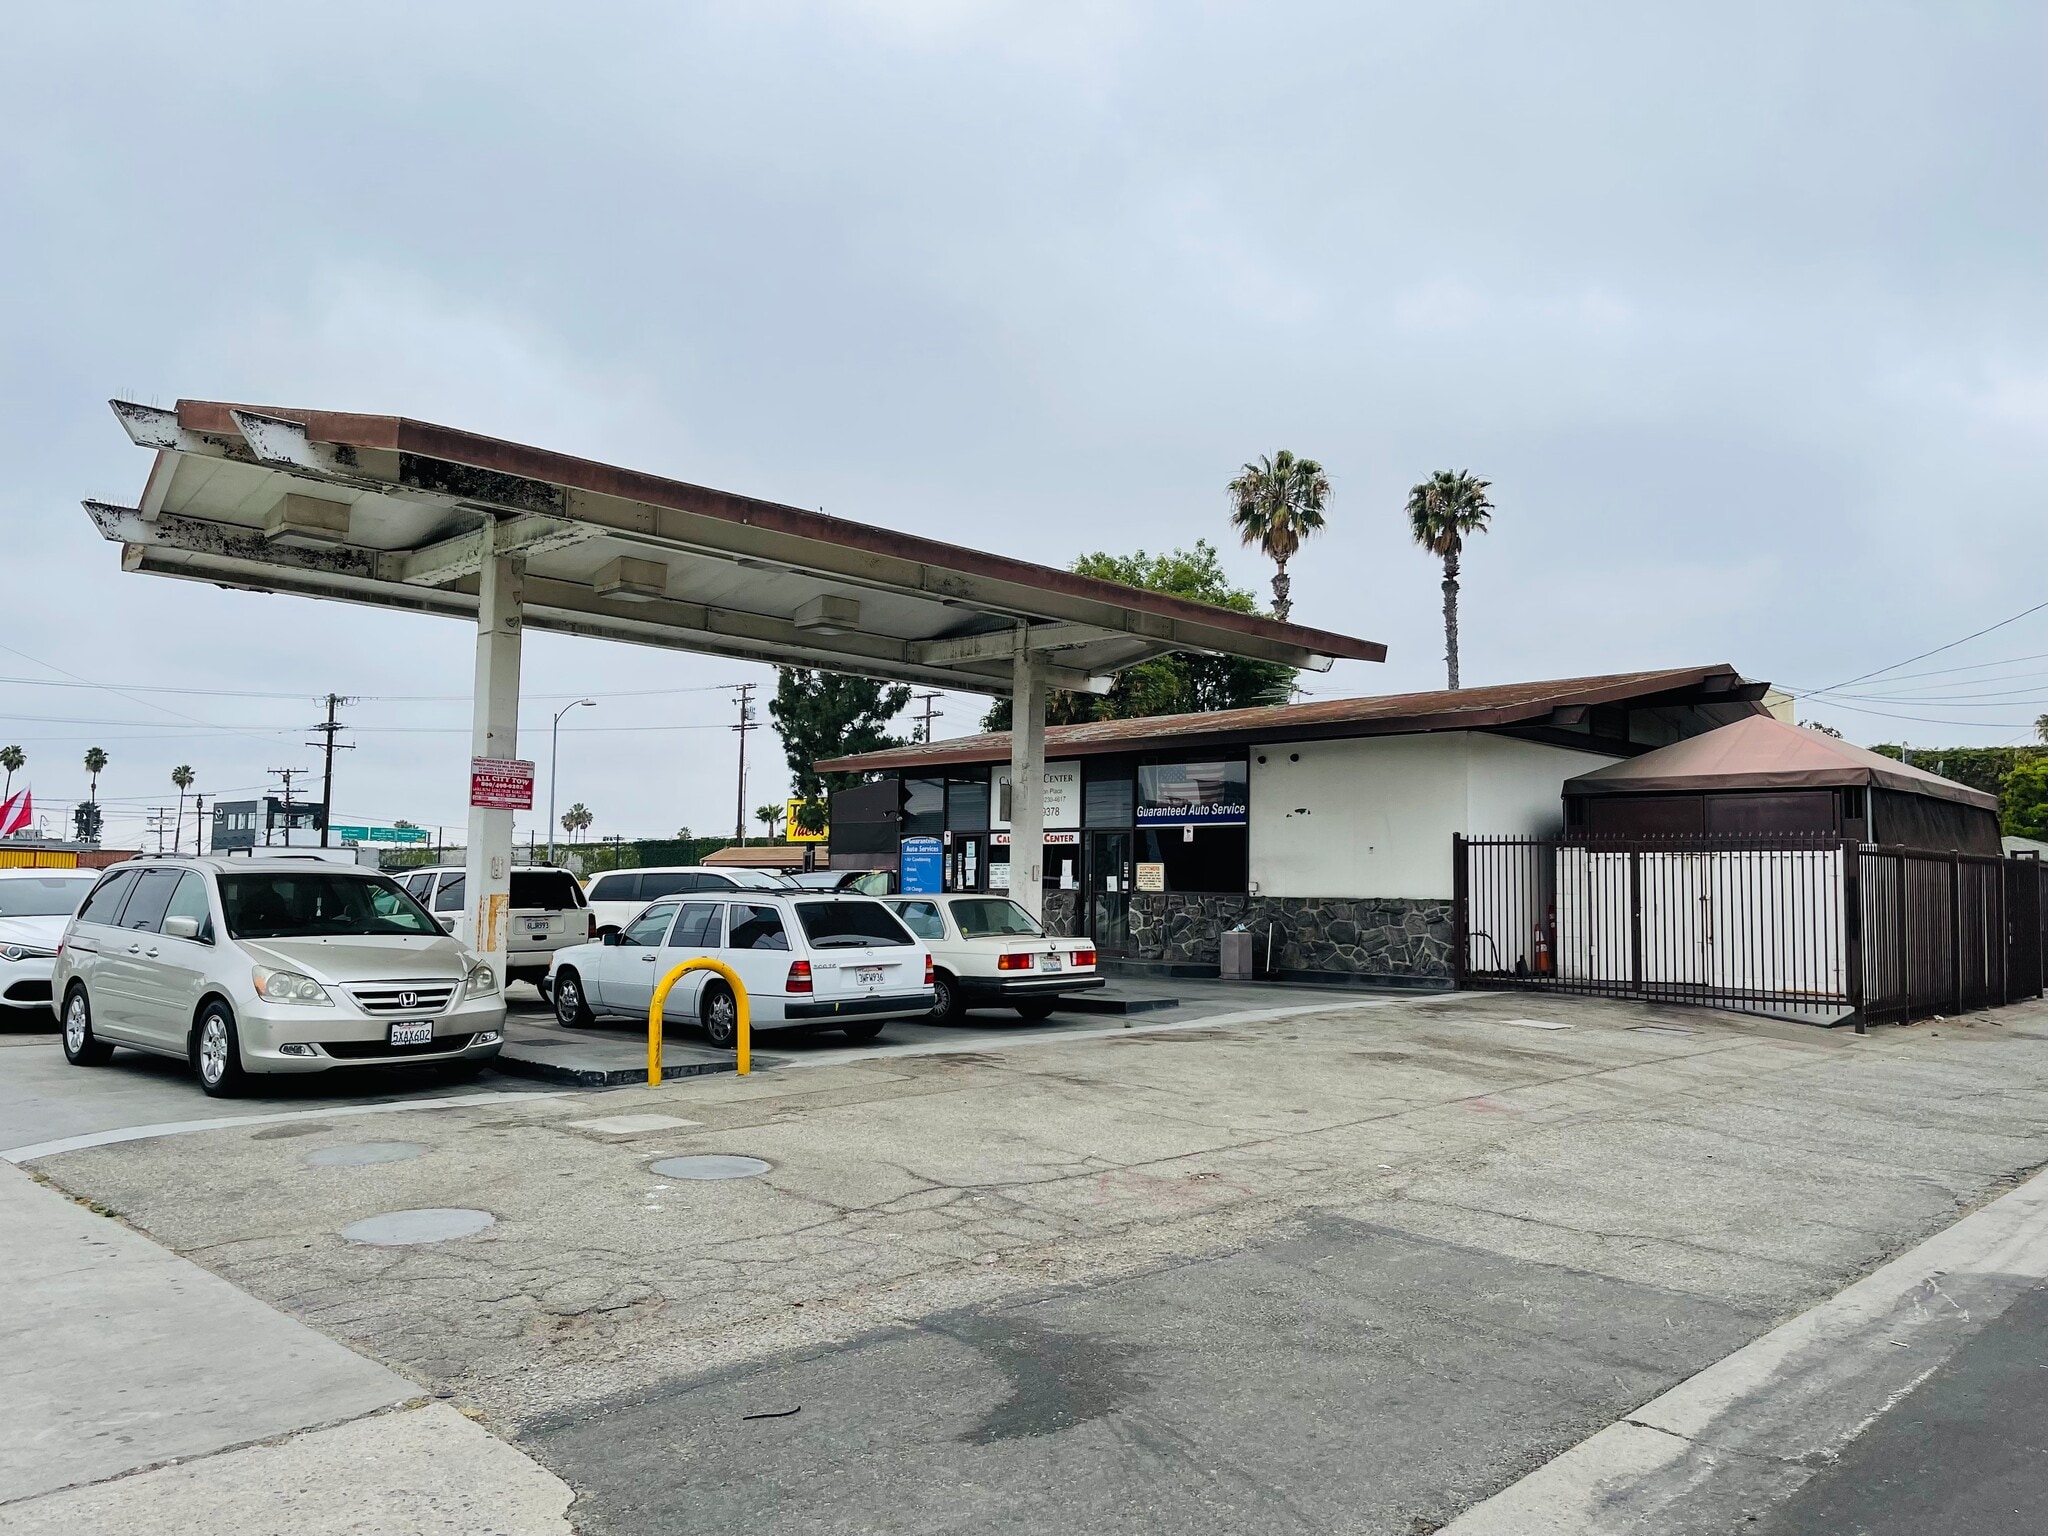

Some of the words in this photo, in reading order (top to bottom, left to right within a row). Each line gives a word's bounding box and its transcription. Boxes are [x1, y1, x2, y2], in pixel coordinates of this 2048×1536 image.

[1044, 774, 1073, 783] CENTER
[1137, 804, 1187, 817] Guaranteed
[1188, 804, 1209, 815] Auto
[1211, 803, 1245, 815] Service
[1044, 834, 1074, 843] CENTER
[393, 1030, 430, 1042] 5XAX602
